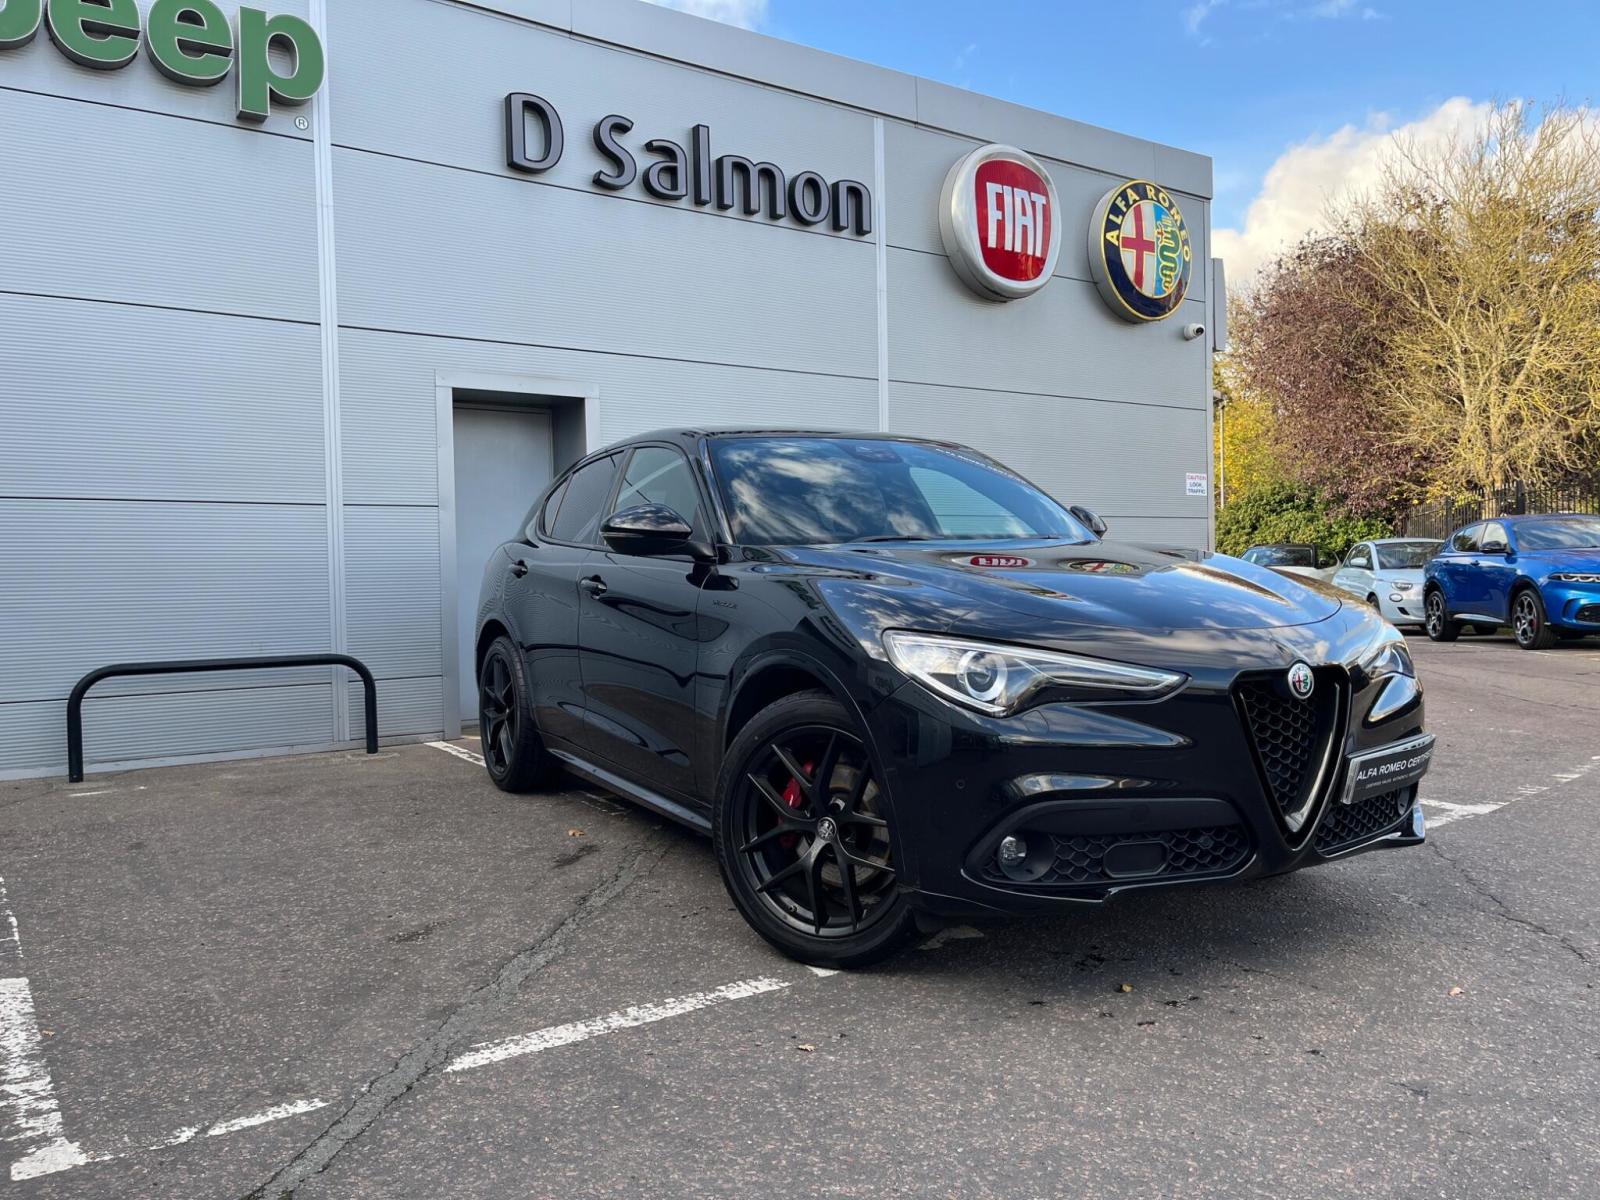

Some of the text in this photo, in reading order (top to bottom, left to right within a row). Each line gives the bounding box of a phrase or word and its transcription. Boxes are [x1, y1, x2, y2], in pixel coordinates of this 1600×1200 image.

[504, 92, 872, 236] D Salmon
[986, 182, 1046, 258] FIAT
[1105, 184, 1190, 262] ALFA ROMEO
[1356, 767, 1377, 781] ALFA
[1379, 760, 1407, 775] ROMEO
